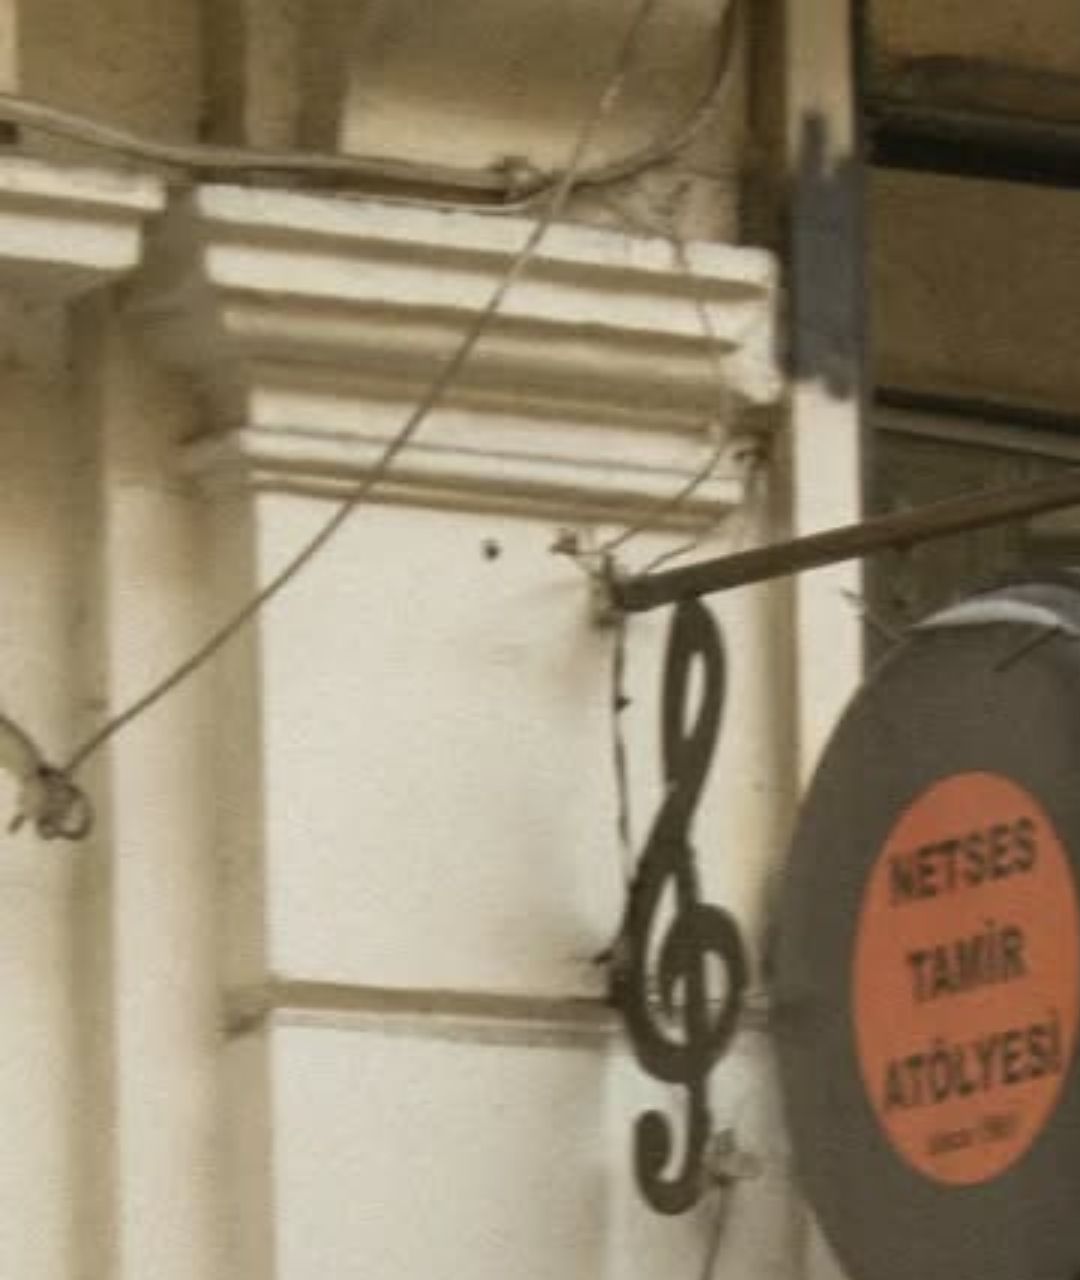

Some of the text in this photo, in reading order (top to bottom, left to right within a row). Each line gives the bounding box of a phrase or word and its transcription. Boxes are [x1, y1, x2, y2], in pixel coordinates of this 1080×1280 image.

[889, 816, 1038, 908] NETSES
[907, 919, 1028, 1003] TAMİR
[883, 1006, 1062, 1111] ATÖLYESİ
